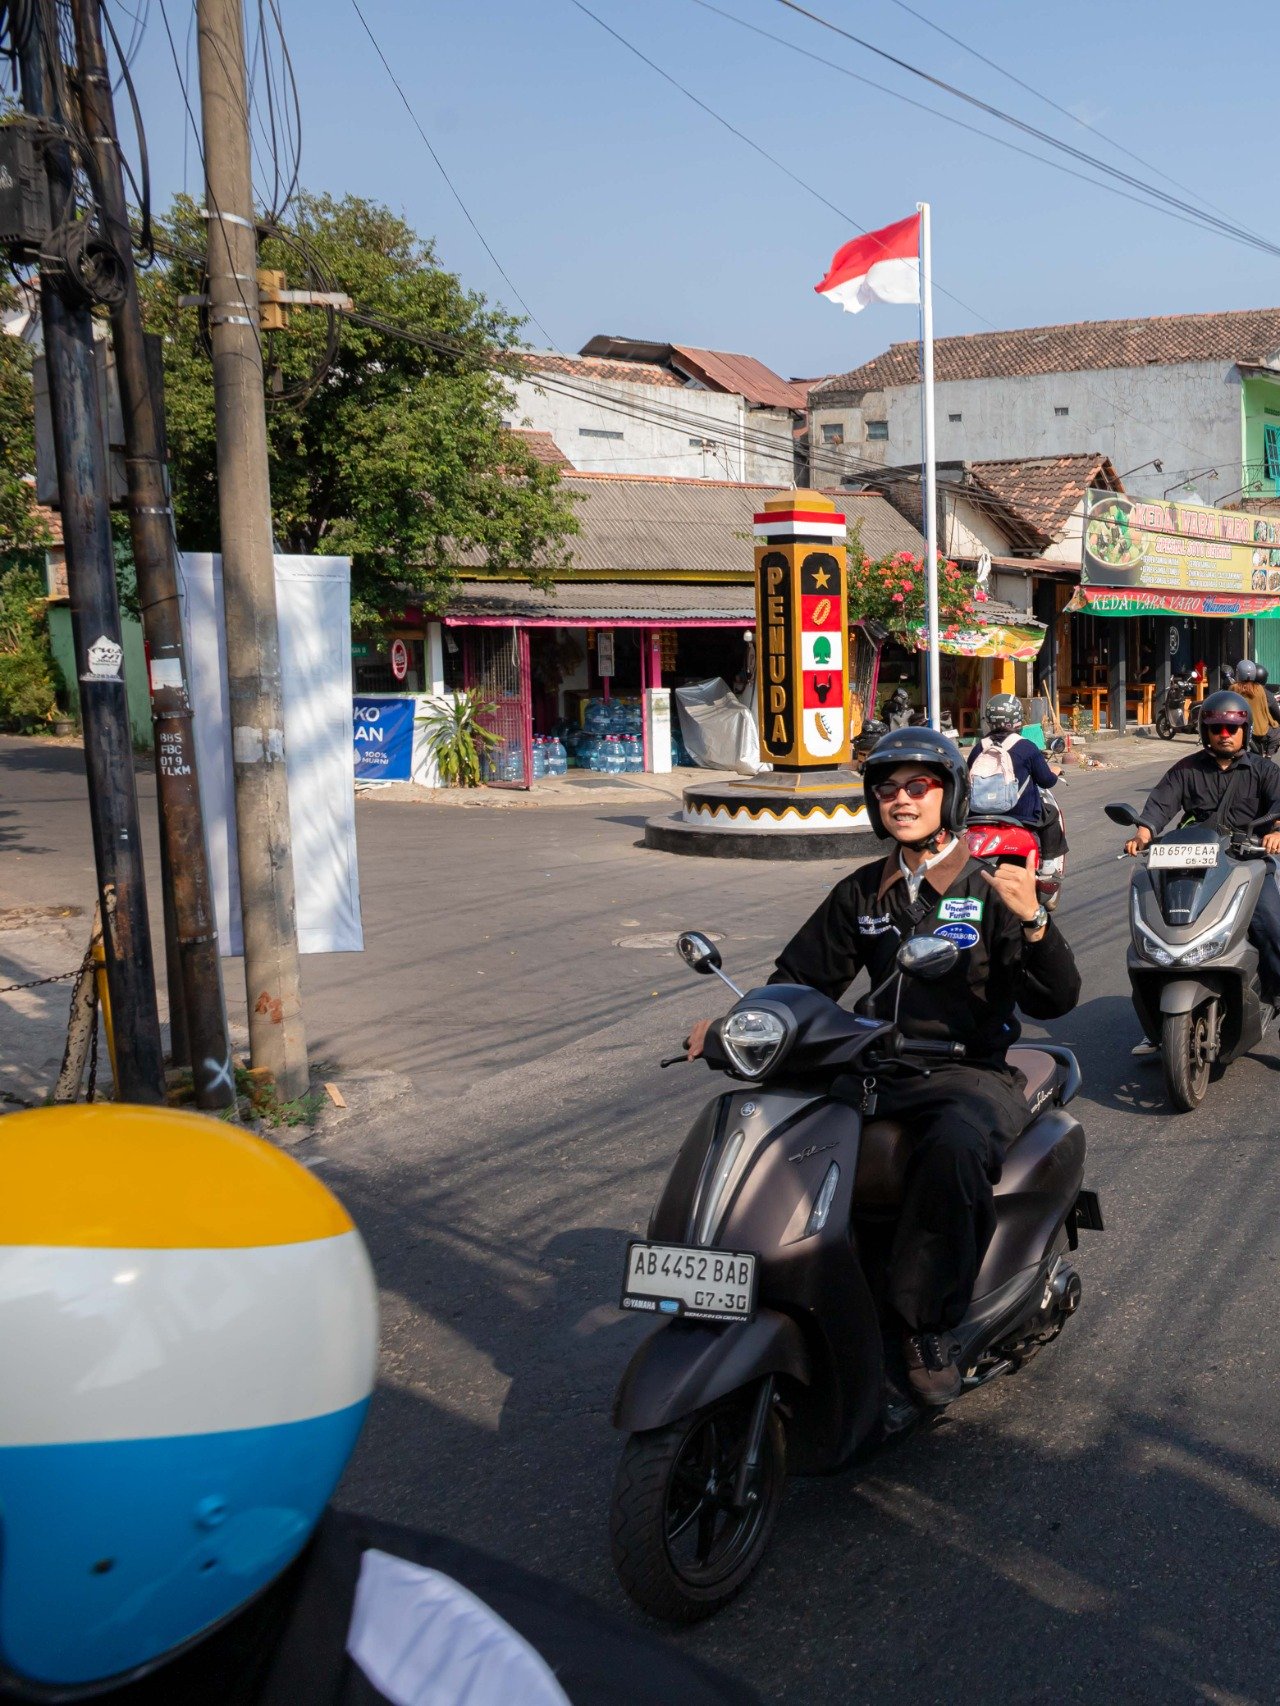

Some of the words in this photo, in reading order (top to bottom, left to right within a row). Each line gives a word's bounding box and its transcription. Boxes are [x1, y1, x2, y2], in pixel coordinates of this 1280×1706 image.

[1135, 503, 1179, 533] KEDAI
[1092, 594, 1133, 611] KEDAI
[1135, 593, 1166, 611] VARA
[1170, 594, 1200, 611] VARO
[767, 566, 788, 743] PEMUDA
[353, 706, 381, 722] KO
[354, 727, 384, 742] AN
[161, 745, 182, 755] FBC
[365, 751, 388, 759] 100%
[160, 756, 183, 766] 019
[161, 765, 191, 776] TLKM
[1152, 847, 1165, 856] AB
[1167, 846, 1193, 856] 6579
[1194, 846, 1215, 856] EAA
[635, 1252, 657, 1276] AB
[661, 1253, 708, 1281] 4452
[713, 1259, 749, 1285] BAB
[630, 1300, 656, 1310] YAMAHA
